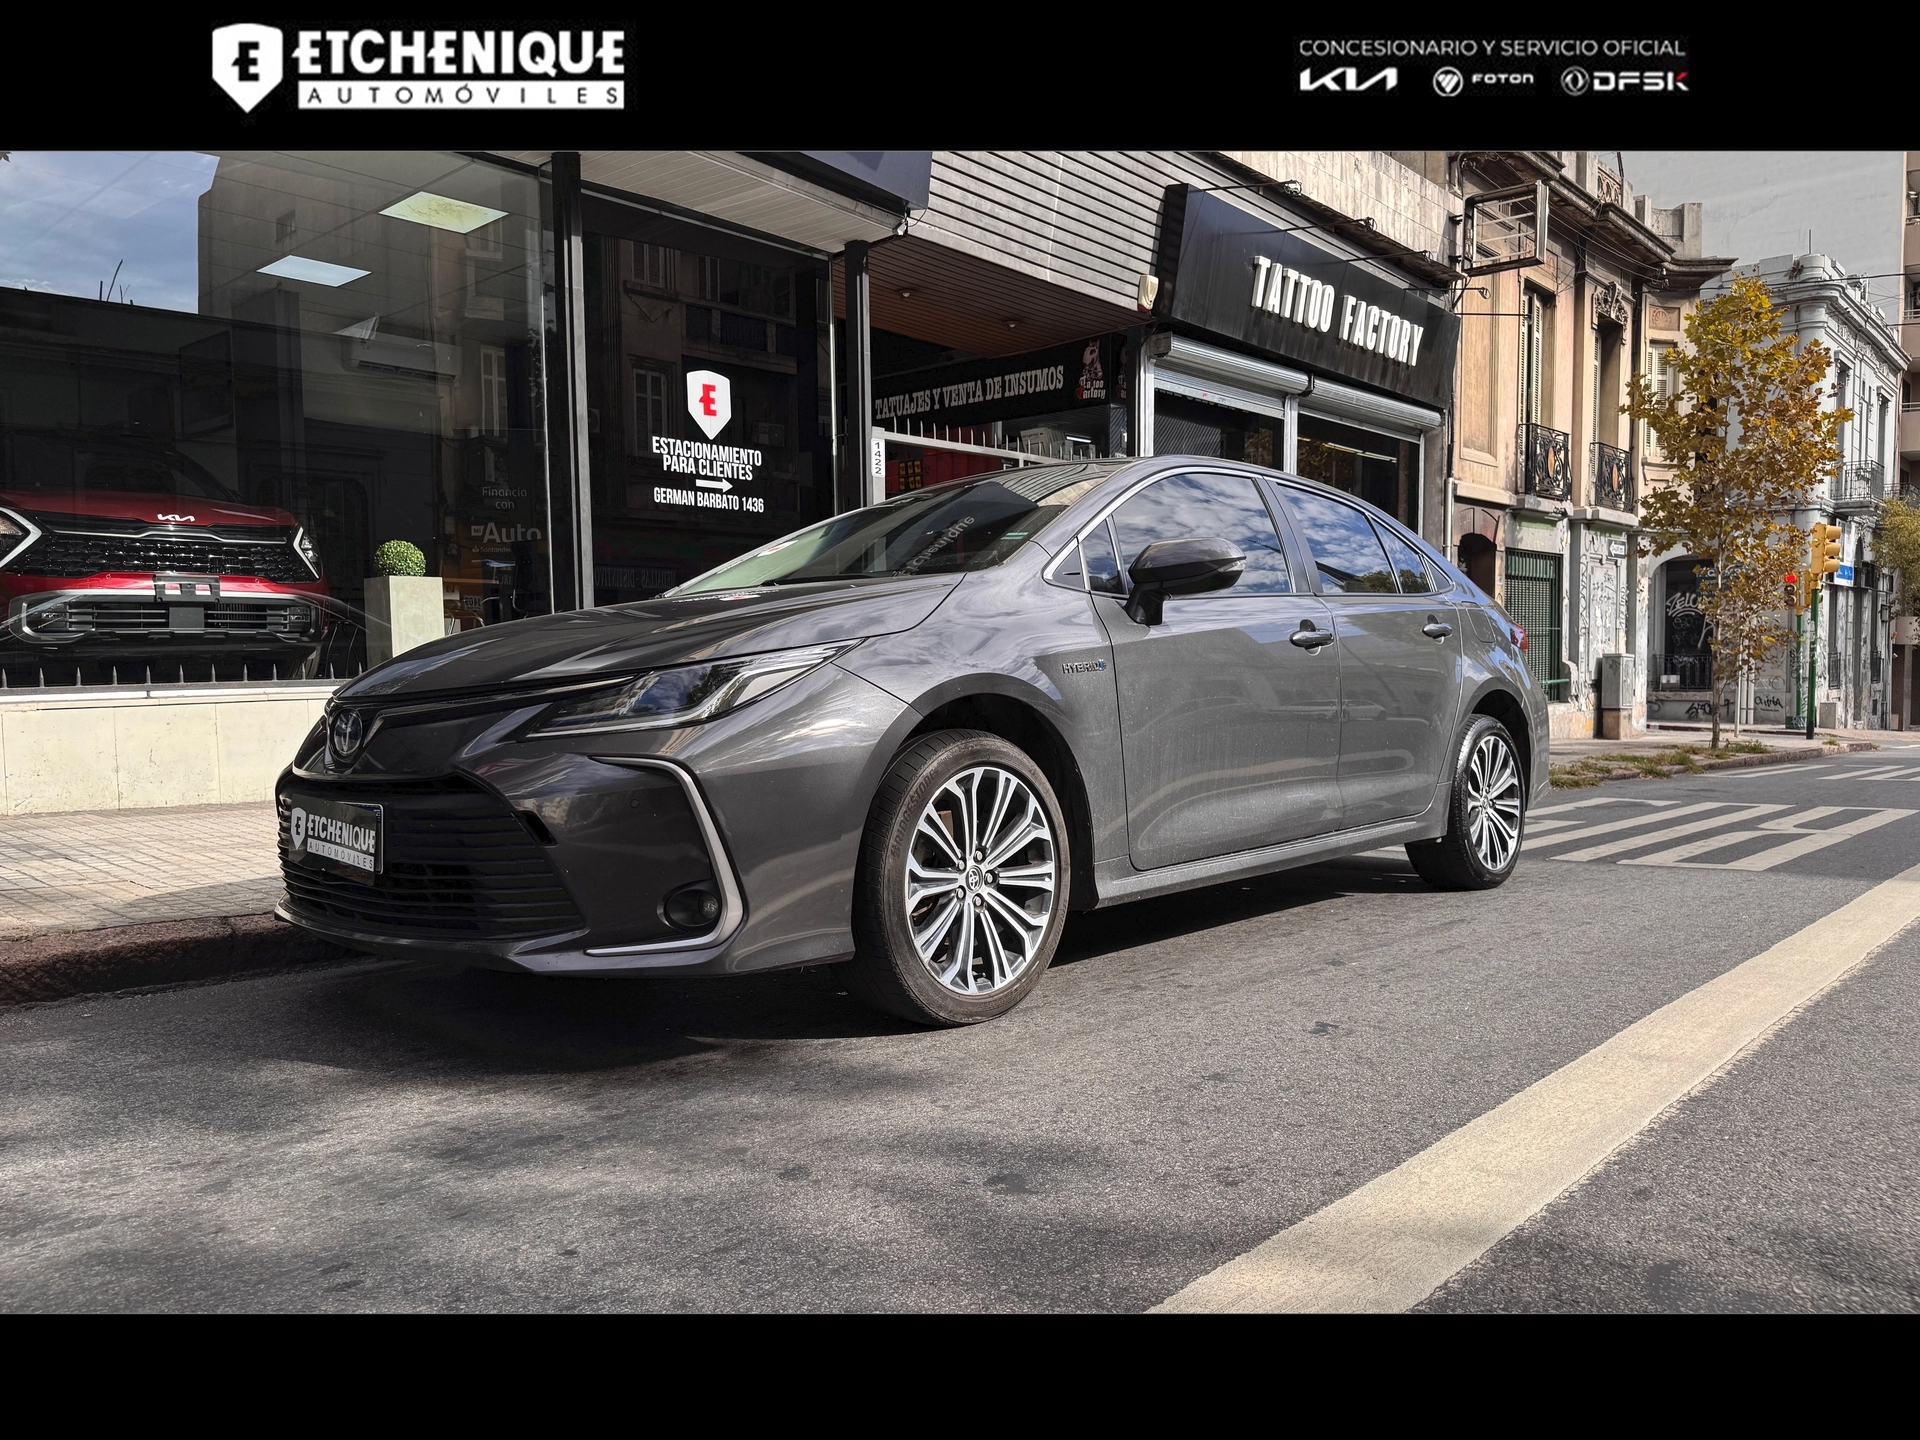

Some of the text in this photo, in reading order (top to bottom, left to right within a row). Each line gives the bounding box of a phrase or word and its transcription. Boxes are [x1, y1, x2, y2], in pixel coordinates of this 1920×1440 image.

[1251, 255, 1425, 367] TATTOO FACTORY
[875, 365, 1064, 420] TATUAJES Y VENTA DE INSUMOS
[652, 436, 763, 467] ESTACIONAMIENTO
[874, 441, 882, 475] 1422
[662, 454, 753, 481] PARA CLIENTES
[482, 487, 527, 497] Financia
[495, 501, 515, 510] con
[653, 487, 765, 513] GERMAN BARBATO 1436
[482, 522, 542, 543] Auto
[1062, 660, 1102, 675] HYBRID
[307, 813, 376, 854] ETCHENIQUE
